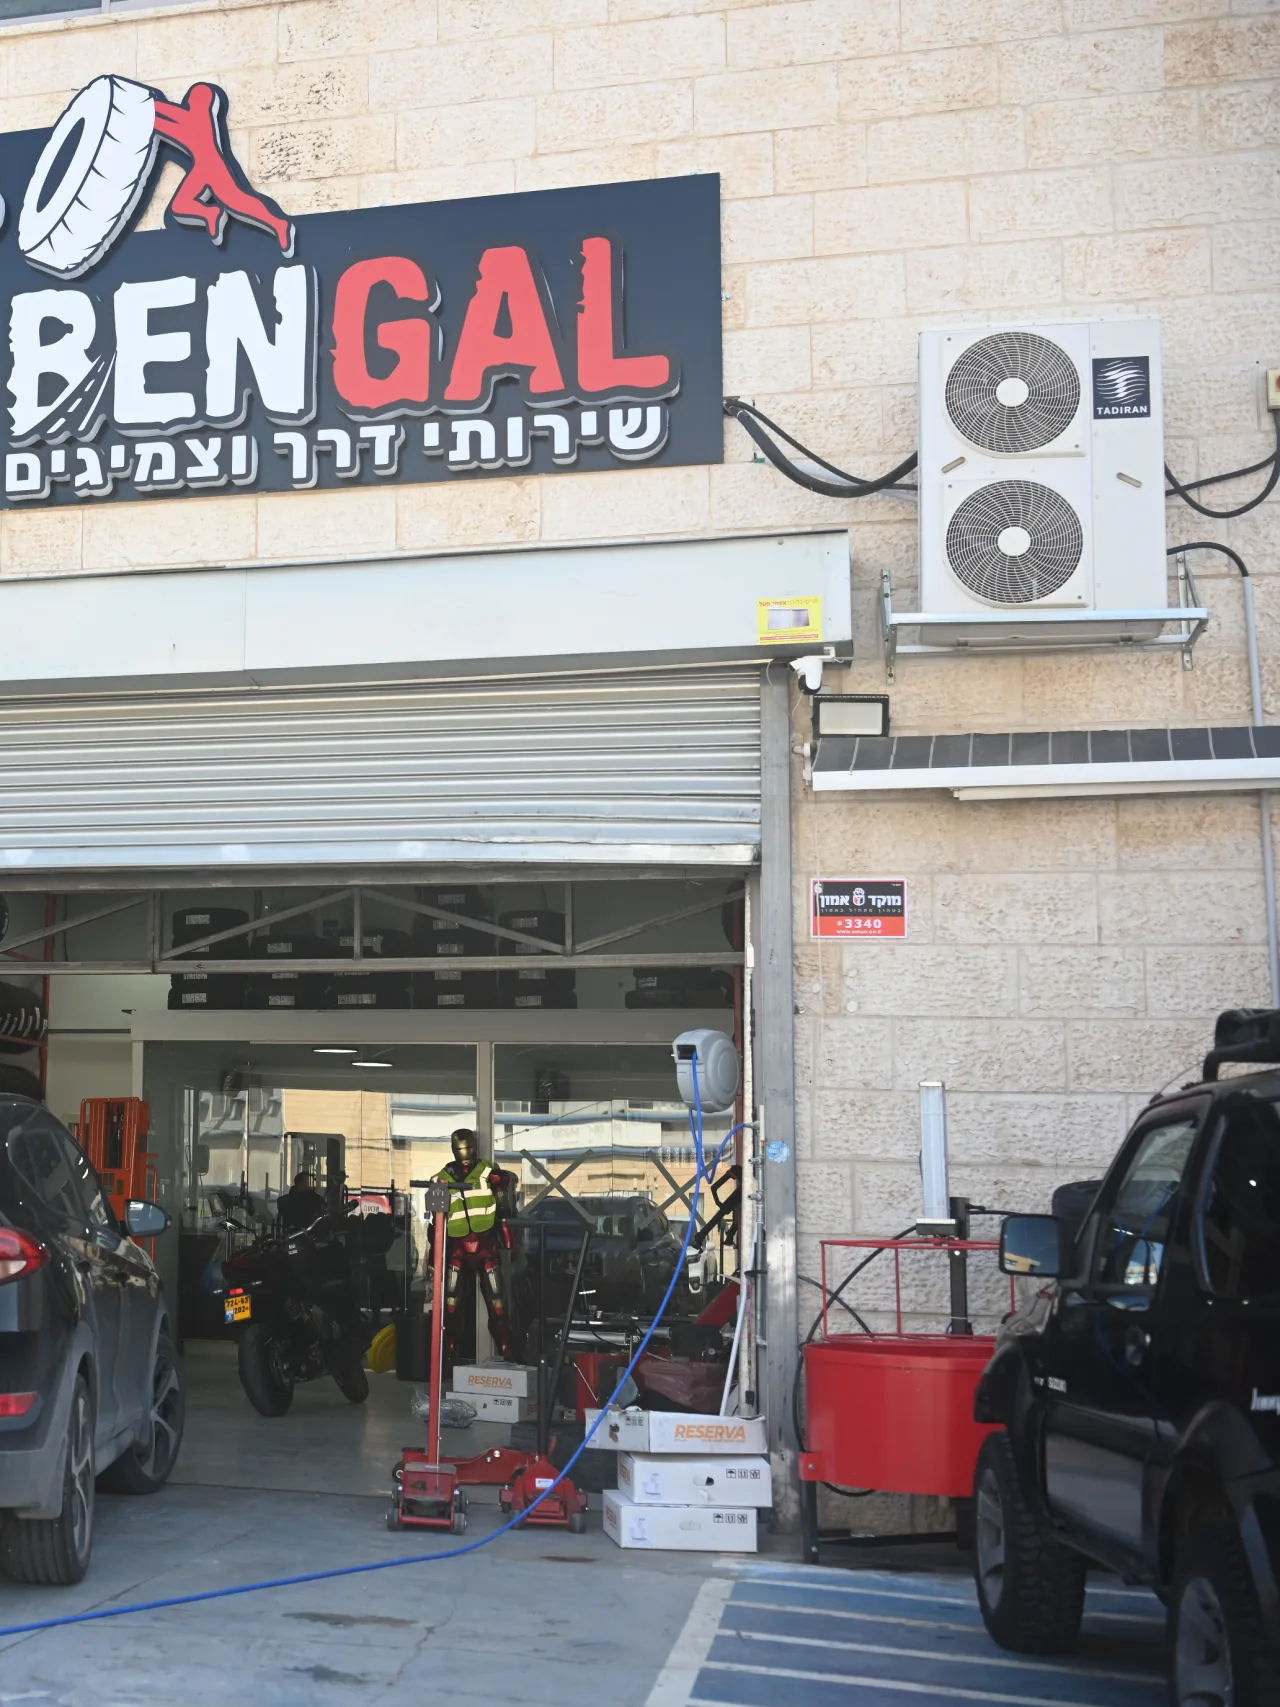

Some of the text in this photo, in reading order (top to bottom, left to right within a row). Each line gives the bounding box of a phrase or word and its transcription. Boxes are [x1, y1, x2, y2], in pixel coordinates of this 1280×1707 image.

[1096, 405, 1148, 415] TADIRAN
[5, 406, 662, 493] שירותי דרך וצמיגים
[819, 895, 902, 908] מוקד אמון
[467, 1375, 513, 1387] RESERVA
[674, 1423, 747, 1440] RESERVA
